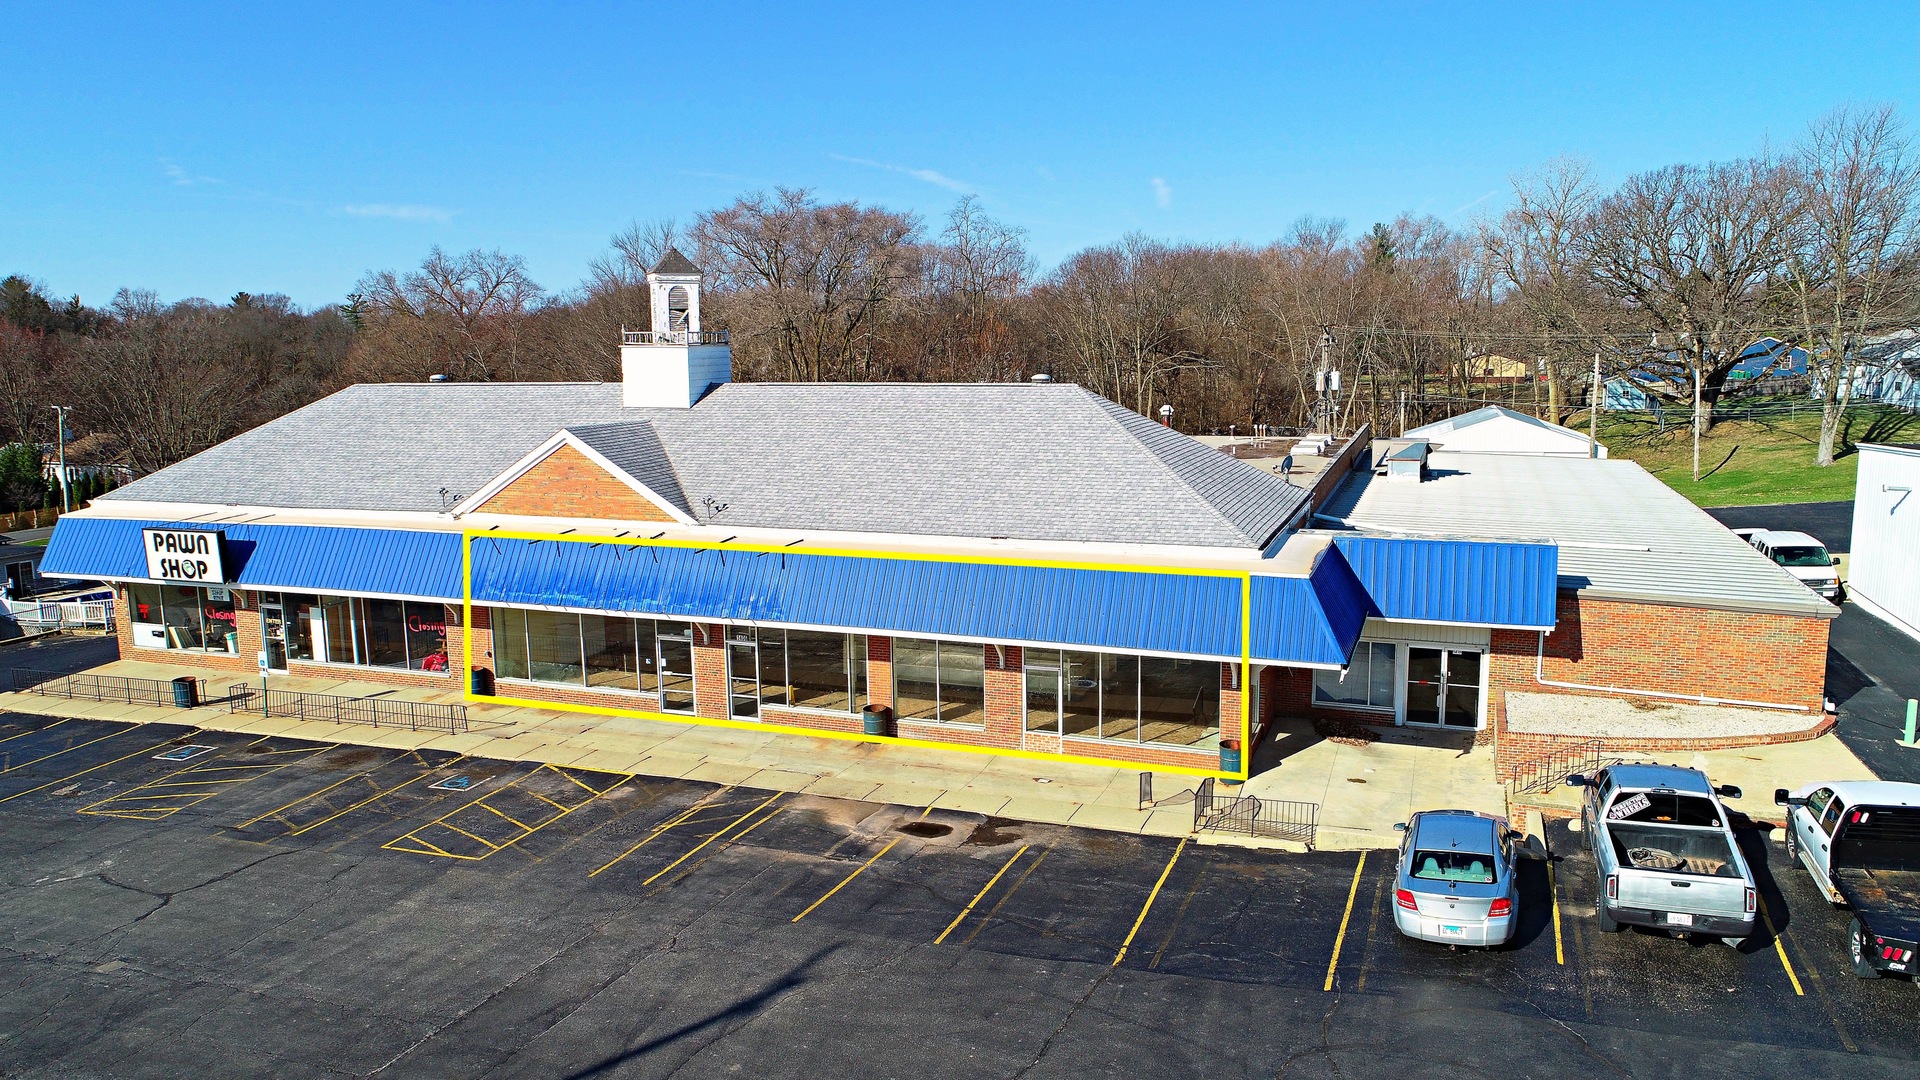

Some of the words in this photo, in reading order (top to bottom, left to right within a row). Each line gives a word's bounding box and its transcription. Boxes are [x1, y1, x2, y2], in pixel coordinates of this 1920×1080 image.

[153, 533, 209, 554] PAWN
[160, 558, 208, 579] SHOP
[205, 604, 236, 627] Closing
[408, 615, 445, 636] Closing
[1615, 799, 1650, 819] WHEELS
